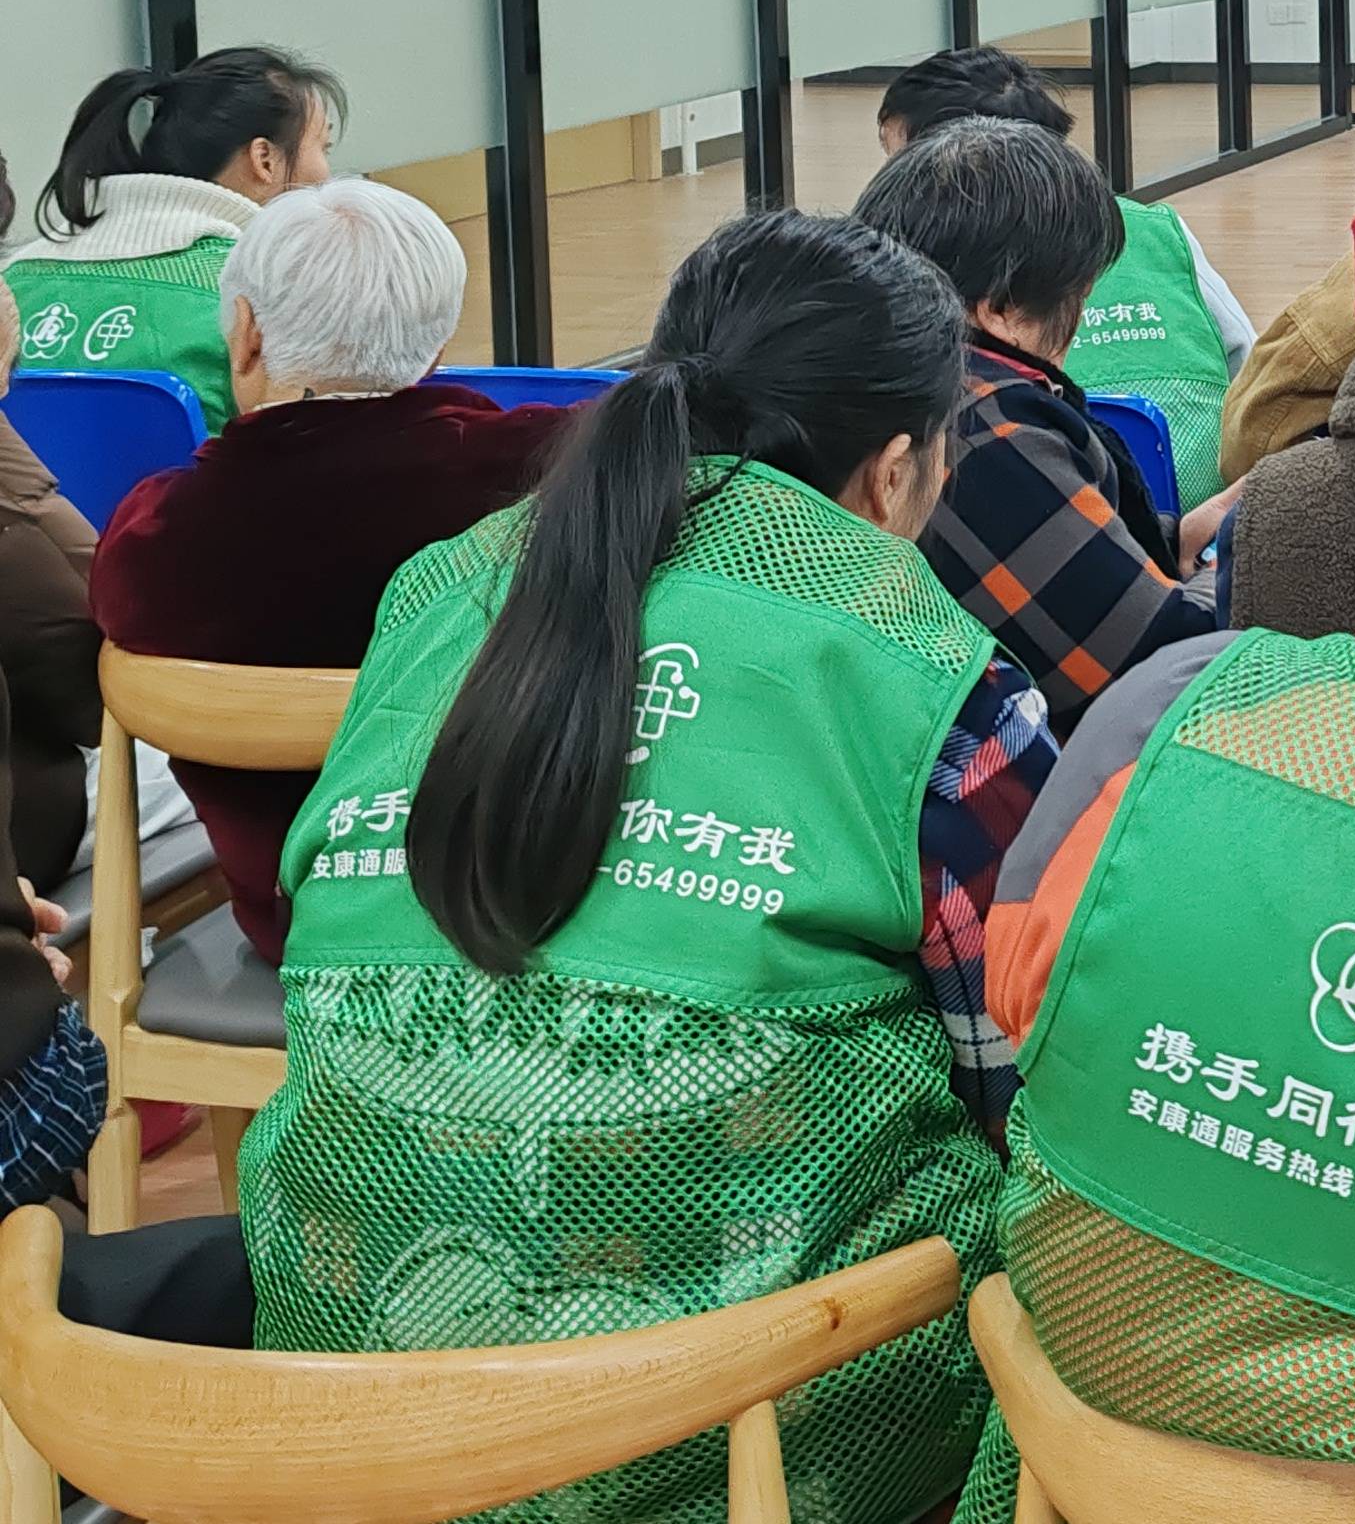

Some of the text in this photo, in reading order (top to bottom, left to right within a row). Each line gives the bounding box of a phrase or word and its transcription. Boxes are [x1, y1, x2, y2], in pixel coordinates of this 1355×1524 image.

[1083, 302, 1162, 328] 你有我
[620, 798, 796, 875] 你有我
